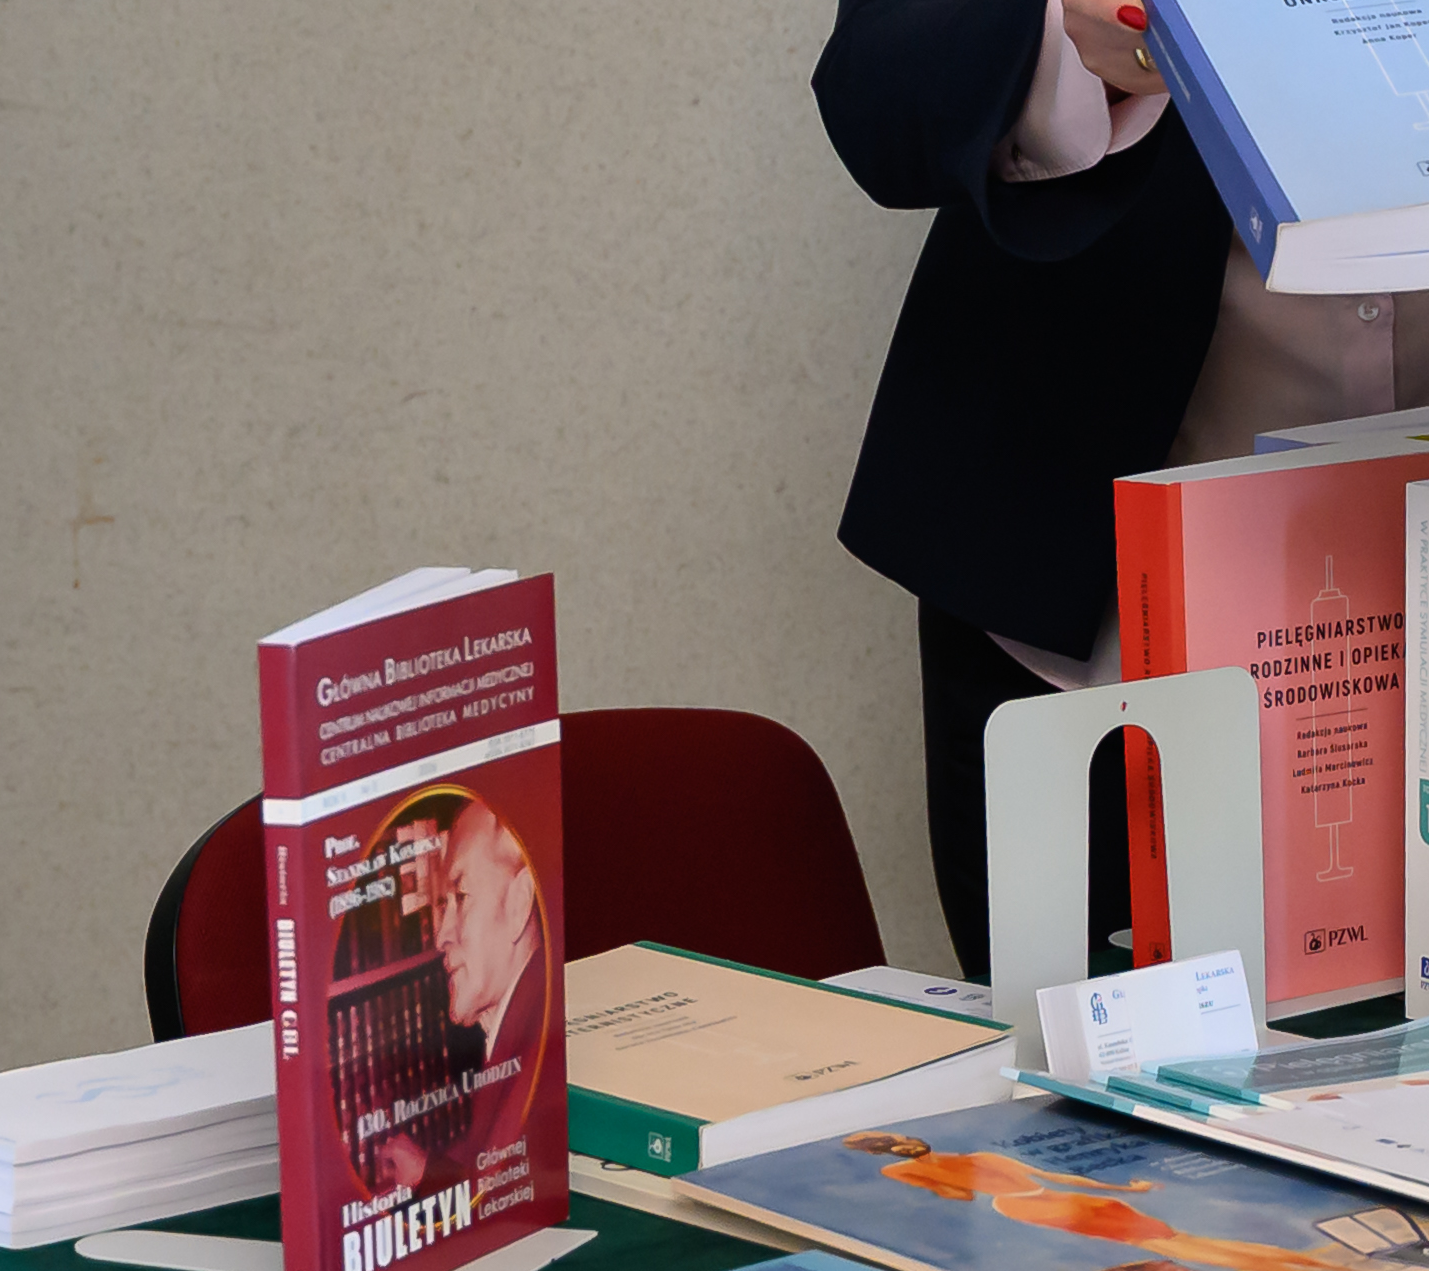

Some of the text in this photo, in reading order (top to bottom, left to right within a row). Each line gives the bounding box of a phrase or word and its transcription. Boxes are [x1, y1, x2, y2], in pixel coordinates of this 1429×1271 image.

[1257, 612, 1405, 649] PIELĘGNIARSTWO
[1418, 519, 1429, 774] W PRAKTYCE SYMULACJI MEDYCZNEJ
[317, 627, 533, 707] GŁÓWNA BIBLIOTEKA LEKARSKA
[1250, 642, 1406, 680] RODZINNE I OPIEK
[461, 686, 535, 719] MEDYCYNY
[1263, 672, 1400, 709] ŚRODOWISKOWA
[1297, 721, 1368, 740] Redakcja naukowa
[1297, 740, 1369, 759] Barbara Ślusarska
[1300, 780, 1341, 794] Katarzyna
[1327, 924, 1369, 948] PZWL
[1195, 967, 1235, 982] LEKARSKA
[566, 996, 699, 1037] TERNISTYCZNE
[393, 1084, 460, 1126] ROCZNICA
[461, 1056, 522, 1094] URODZIN
[476, 1135, 527, 1171] Głównej
[477, 1157, 530, 1192] Biblioteki
[341, 1183, 413, 1228] Historia
[478, 1180, 534, 1220] Lekarskiej
